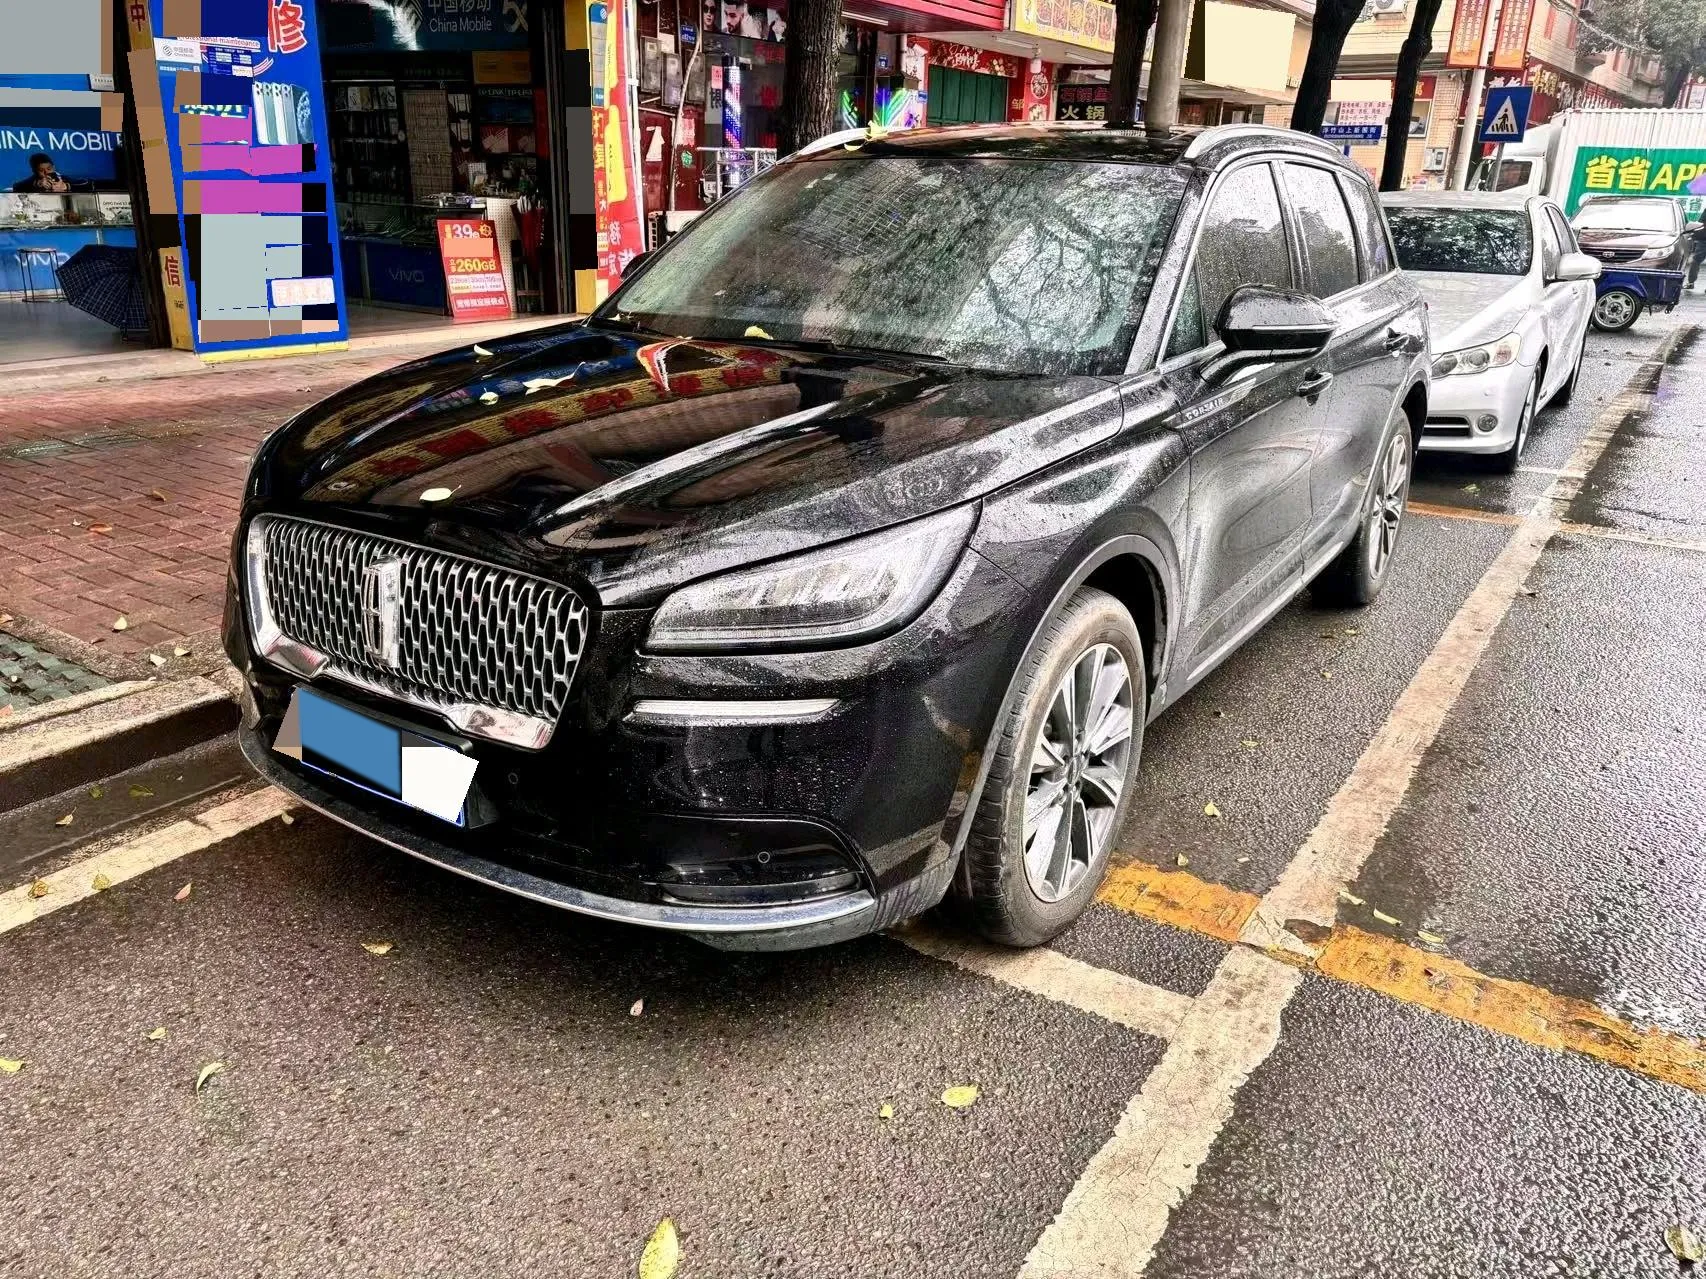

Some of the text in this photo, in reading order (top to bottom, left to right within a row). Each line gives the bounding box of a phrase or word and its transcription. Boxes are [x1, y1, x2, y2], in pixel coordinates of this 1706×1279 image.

[130, 0, 146, 32] 中
[427, 0, 492, 14] 中国移动
[267, 0, 307, 54] 修
[429, 17, 458, 32] China
[459, 15, 492, 31] Mobile
[1061, 105, 1105, 120] 火锅
[0, 130, 44, 150] INA
[165, 255, 181, 287] 信
[456, 258, 496, 273] 260GB
